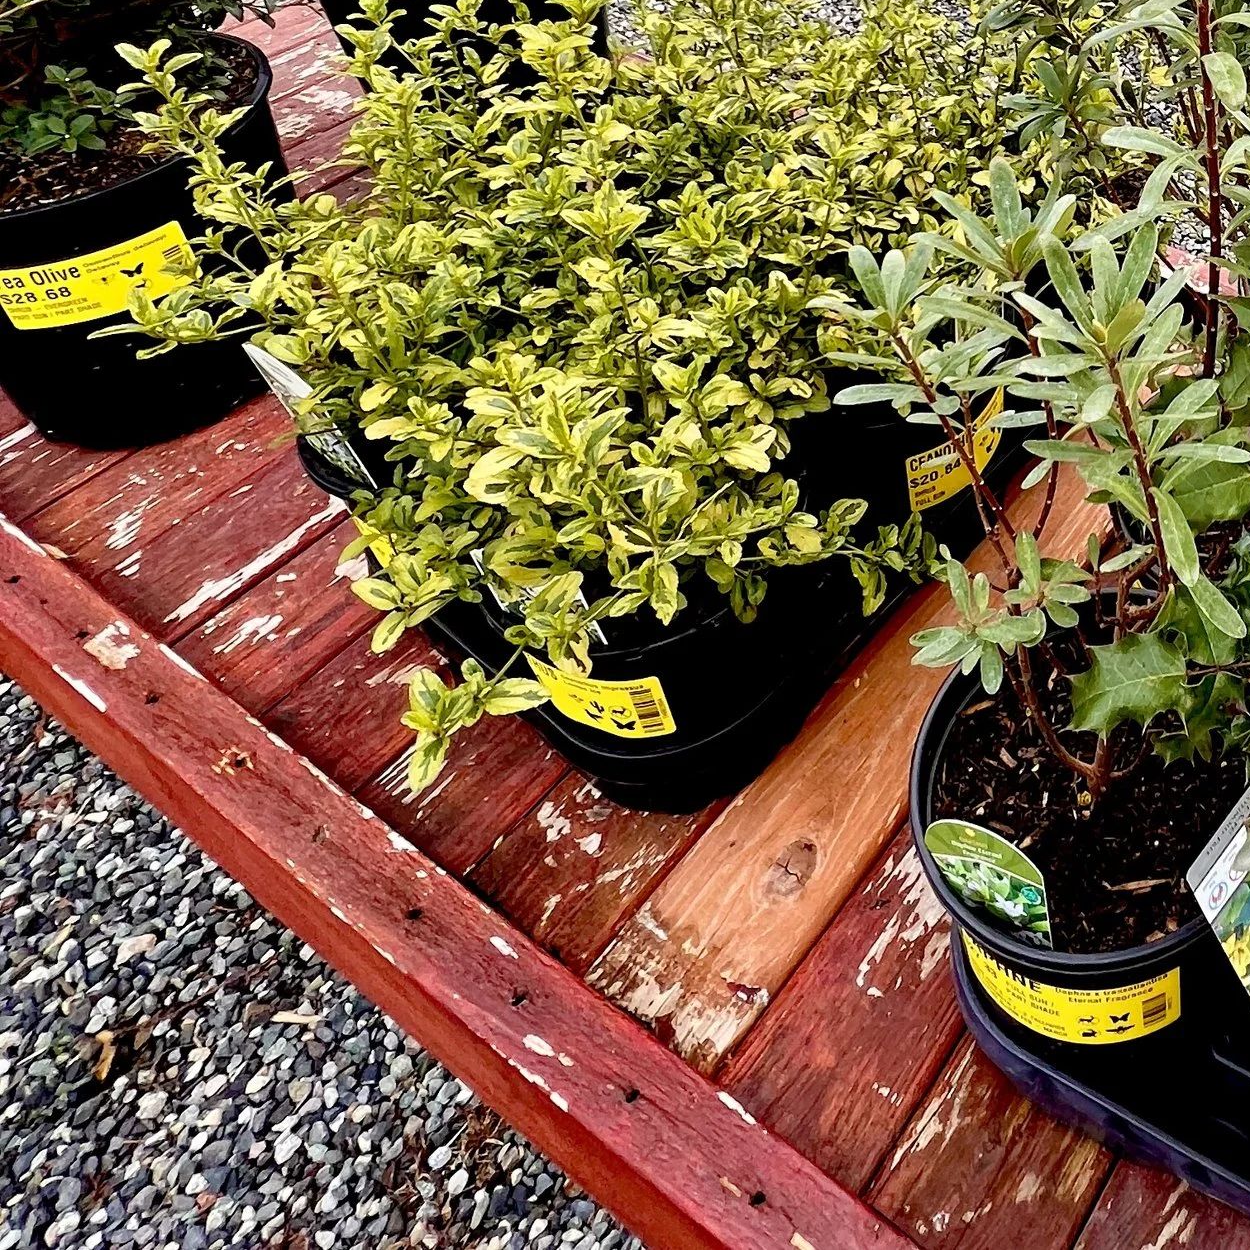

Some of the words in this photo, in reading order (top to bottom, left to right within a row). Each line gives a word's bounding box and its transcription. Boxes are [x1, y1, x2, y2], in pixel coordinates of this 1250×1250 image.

[0, 276, 26, 290] ea
[29, 266, 81, 286] Olive
[0, 286, 72, 305] $28.68
[909, 457, 962, 489] $20.84
[1030, 1001, 1061, 1017] SHADE
